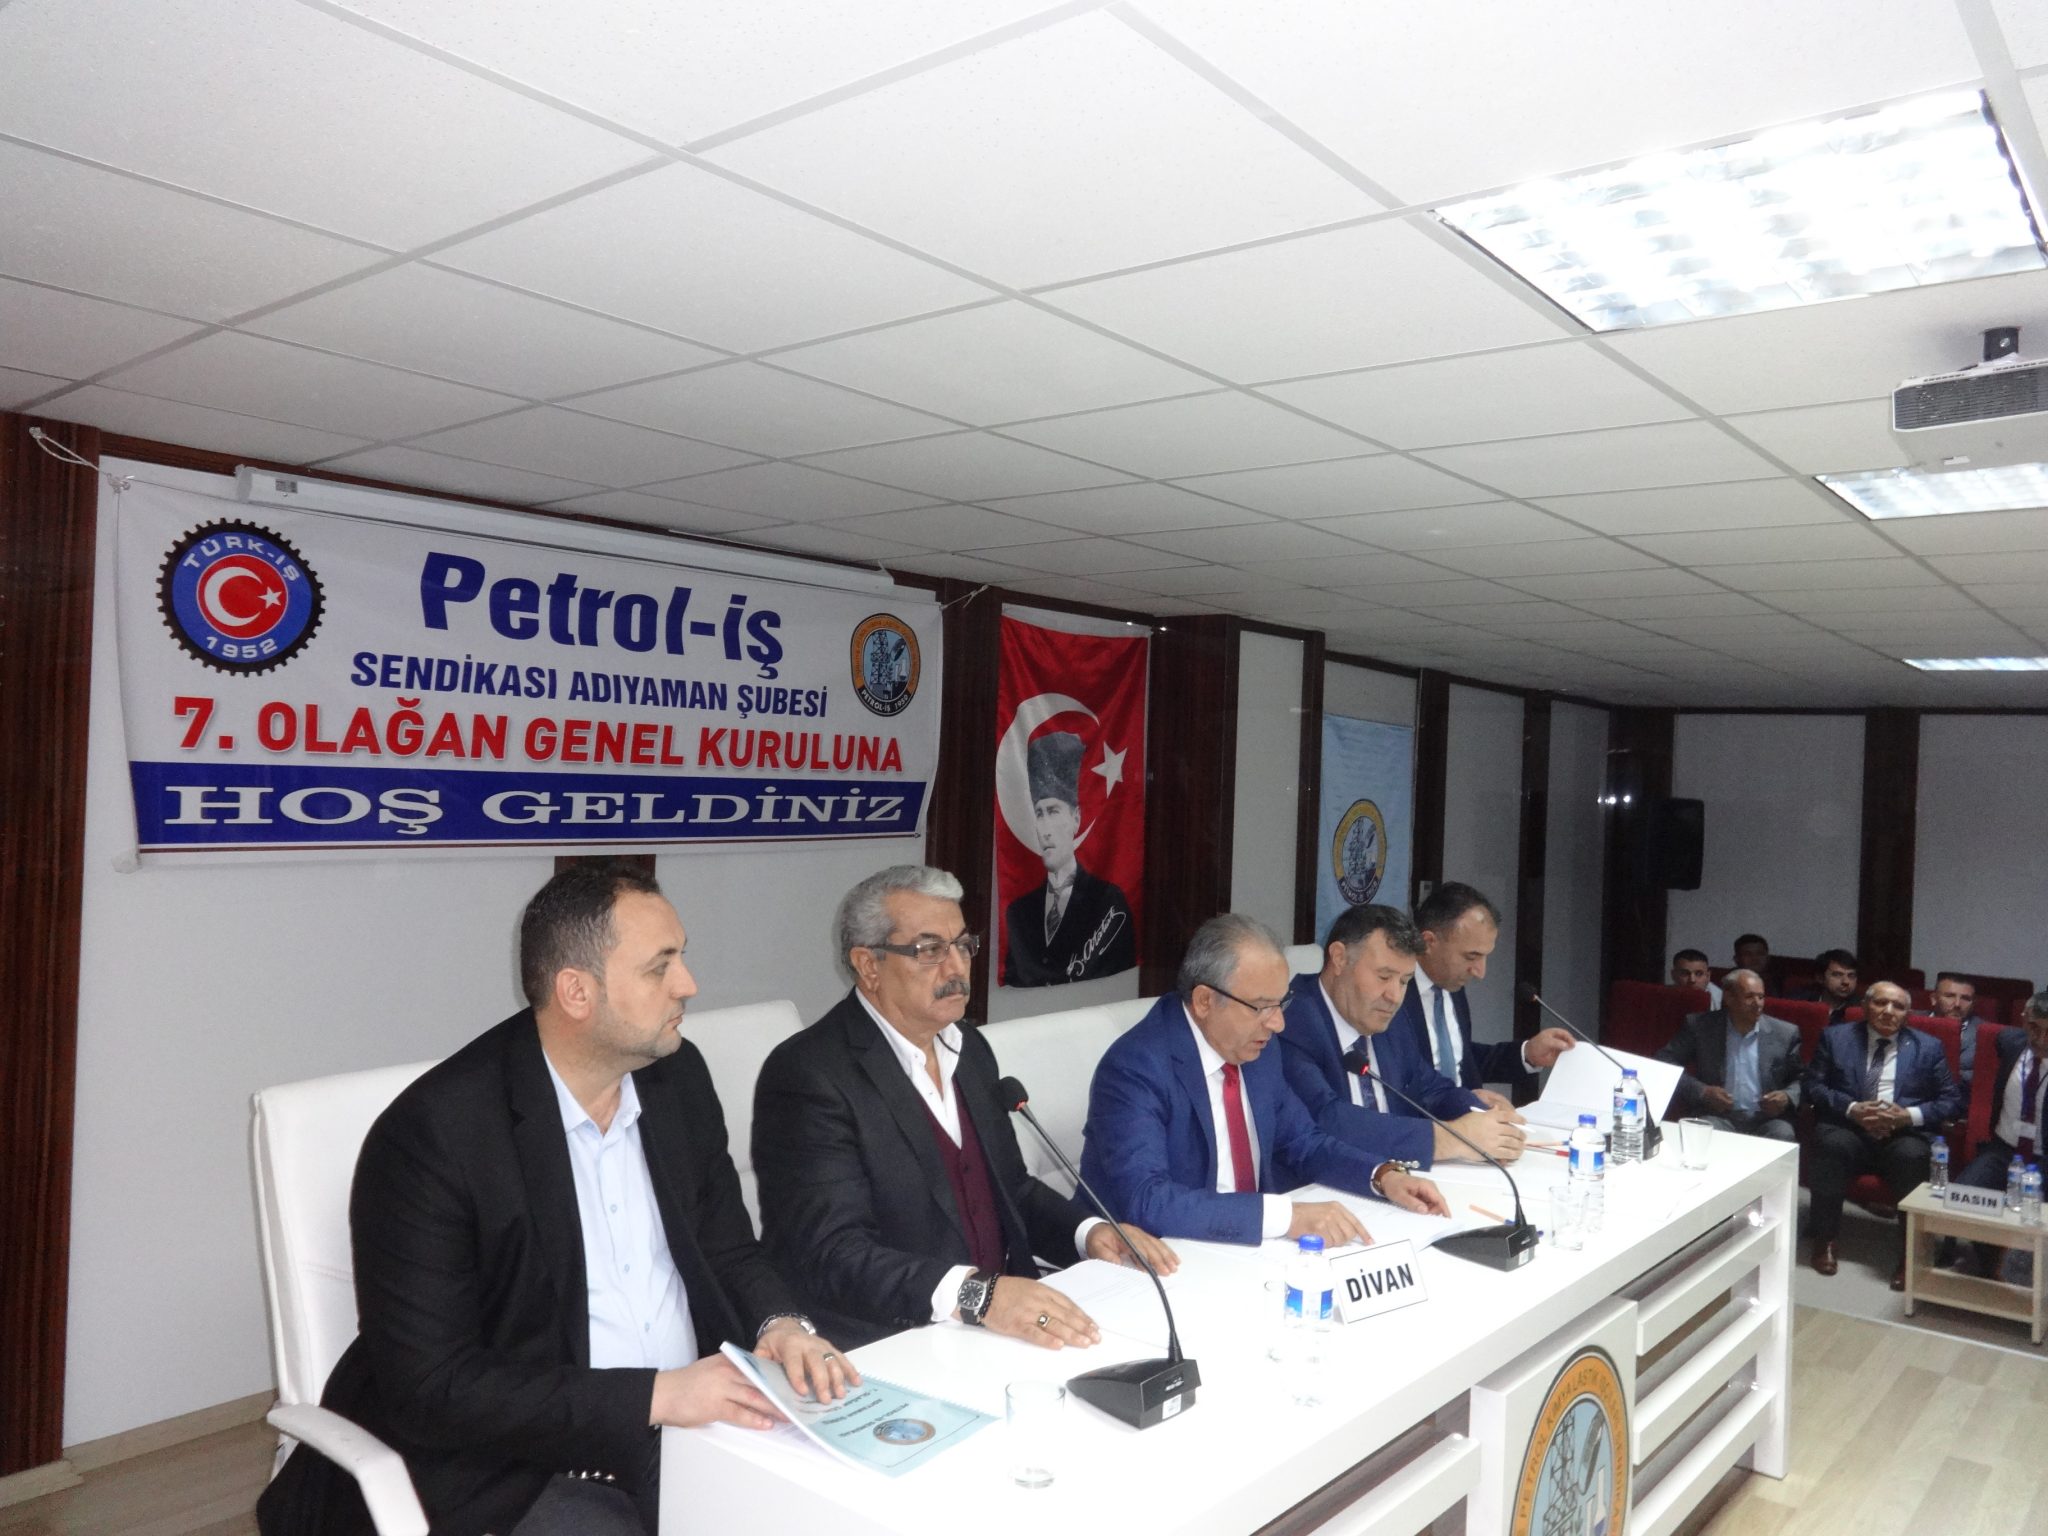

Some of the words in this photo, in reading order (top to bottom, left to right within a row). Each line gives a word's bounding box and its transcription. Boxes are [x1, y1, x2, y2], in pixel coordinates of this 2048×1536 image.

[421, 552, 784, 680] Petrol-iş
[207, 636, 278, 659] 1952
[351, 652, 558, 700] SENDİKASI
[568, 670, 728, 712] ADIYAMAN
[737, 683, 828, 720] ŞUBESİ
[174, 696, 234, 750] 7.
[257, 696, 508, 760] OLAĞAN
[525, 717, 684, 765] GENEL
[698, 727, 903, 772] KURULUNA
[164, 786, 444, 835] HOŞ
[482, 785, 905, 824] GELDİNİZ
[1950, 1191, 1998, 1208] BASIN
[1345, 1262, 1414, 1303] DİVAN
